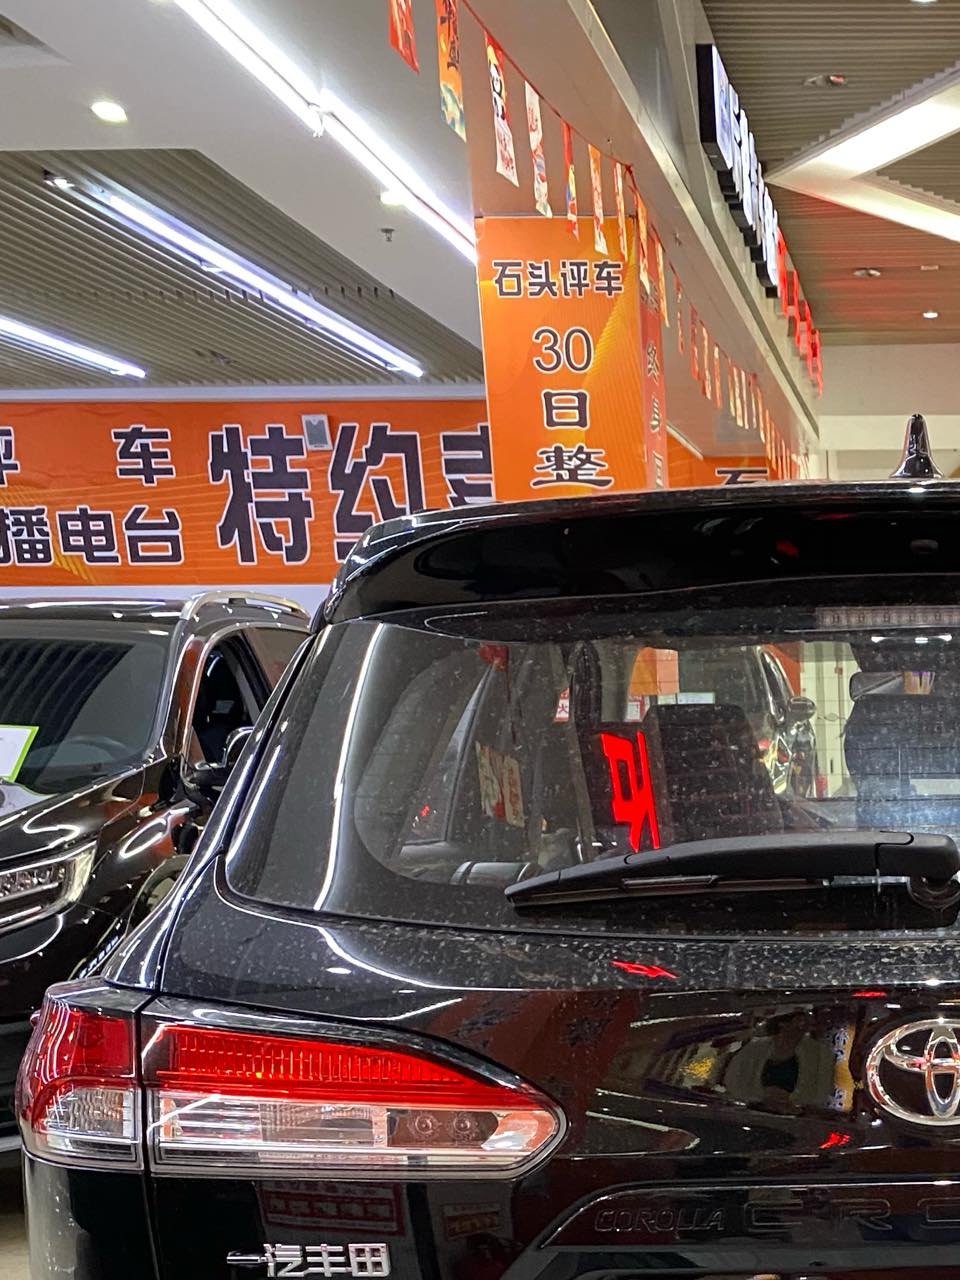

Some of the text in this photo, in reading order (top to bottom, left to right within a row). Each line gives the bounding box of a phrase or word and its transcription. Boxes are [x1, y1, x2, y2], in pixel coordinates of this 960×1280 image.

[491, 259, 624, 298] 石头评车
[0, 504, 184, 566] 播电台
[594, 1206, 726, 1233] COROLLA
[226, 1243, 391, 1277] 一汽丰田
